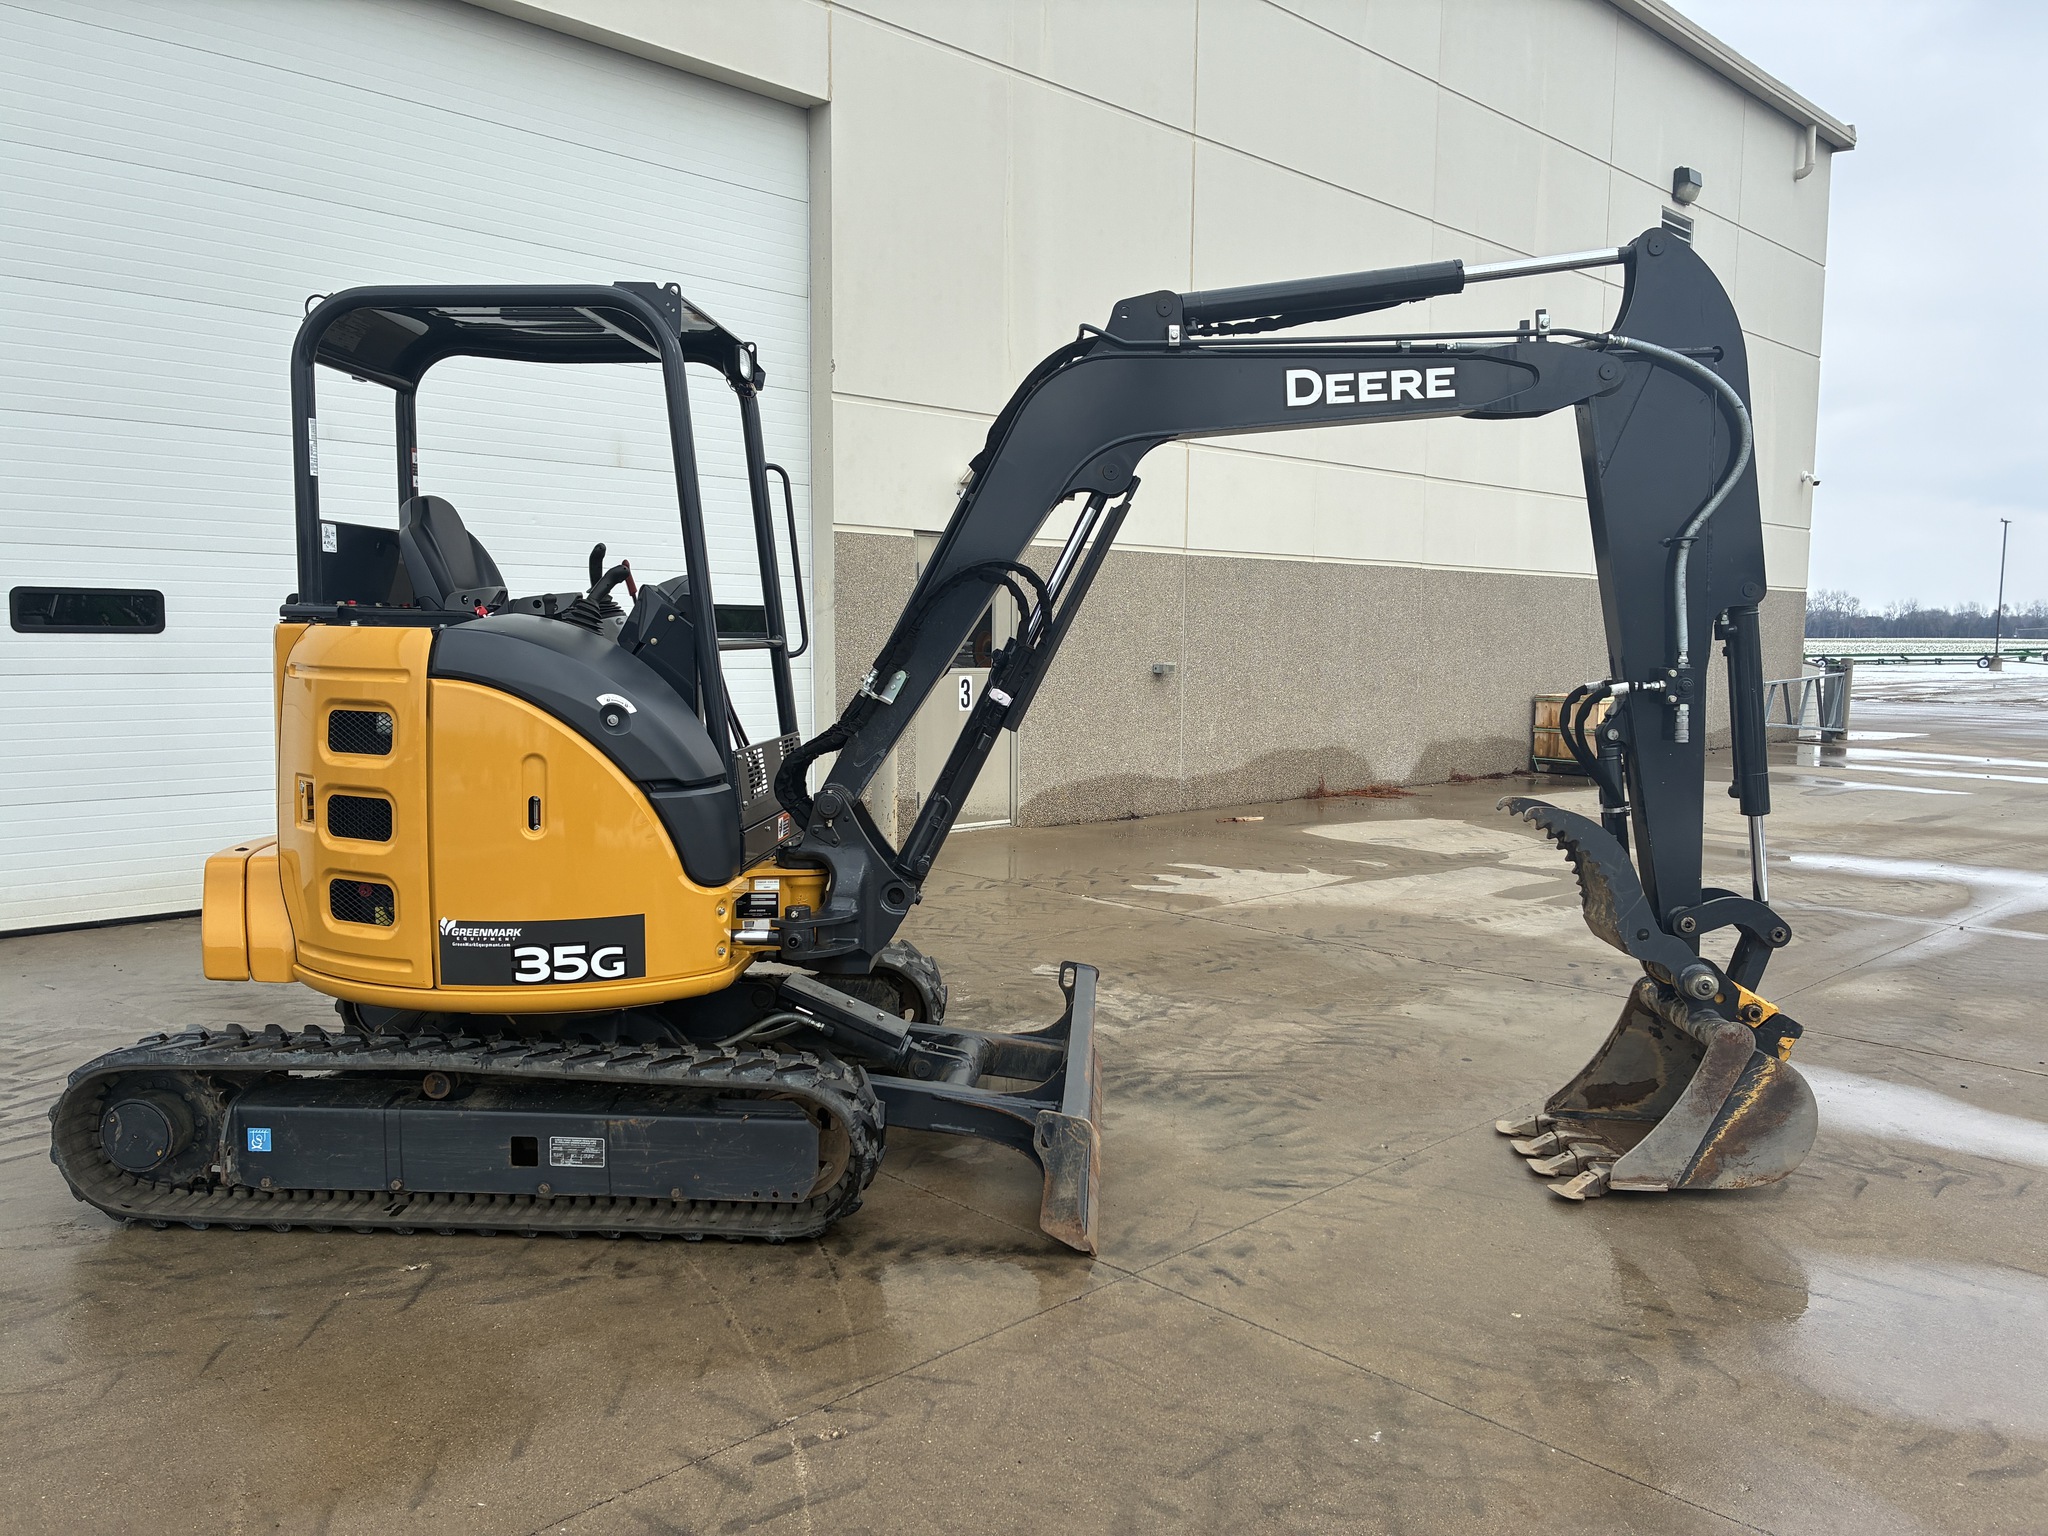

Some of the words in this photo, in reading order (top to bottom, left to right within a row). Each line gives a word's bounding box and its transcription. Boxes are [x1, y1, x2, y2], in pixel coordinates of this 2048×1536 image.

[1286, 367, 1456, 407] DEERE
[961, 679, 970, 708] 3
[451, 928, 522, 937] GREENMARK
[514, 945, 626, 983] 35G
